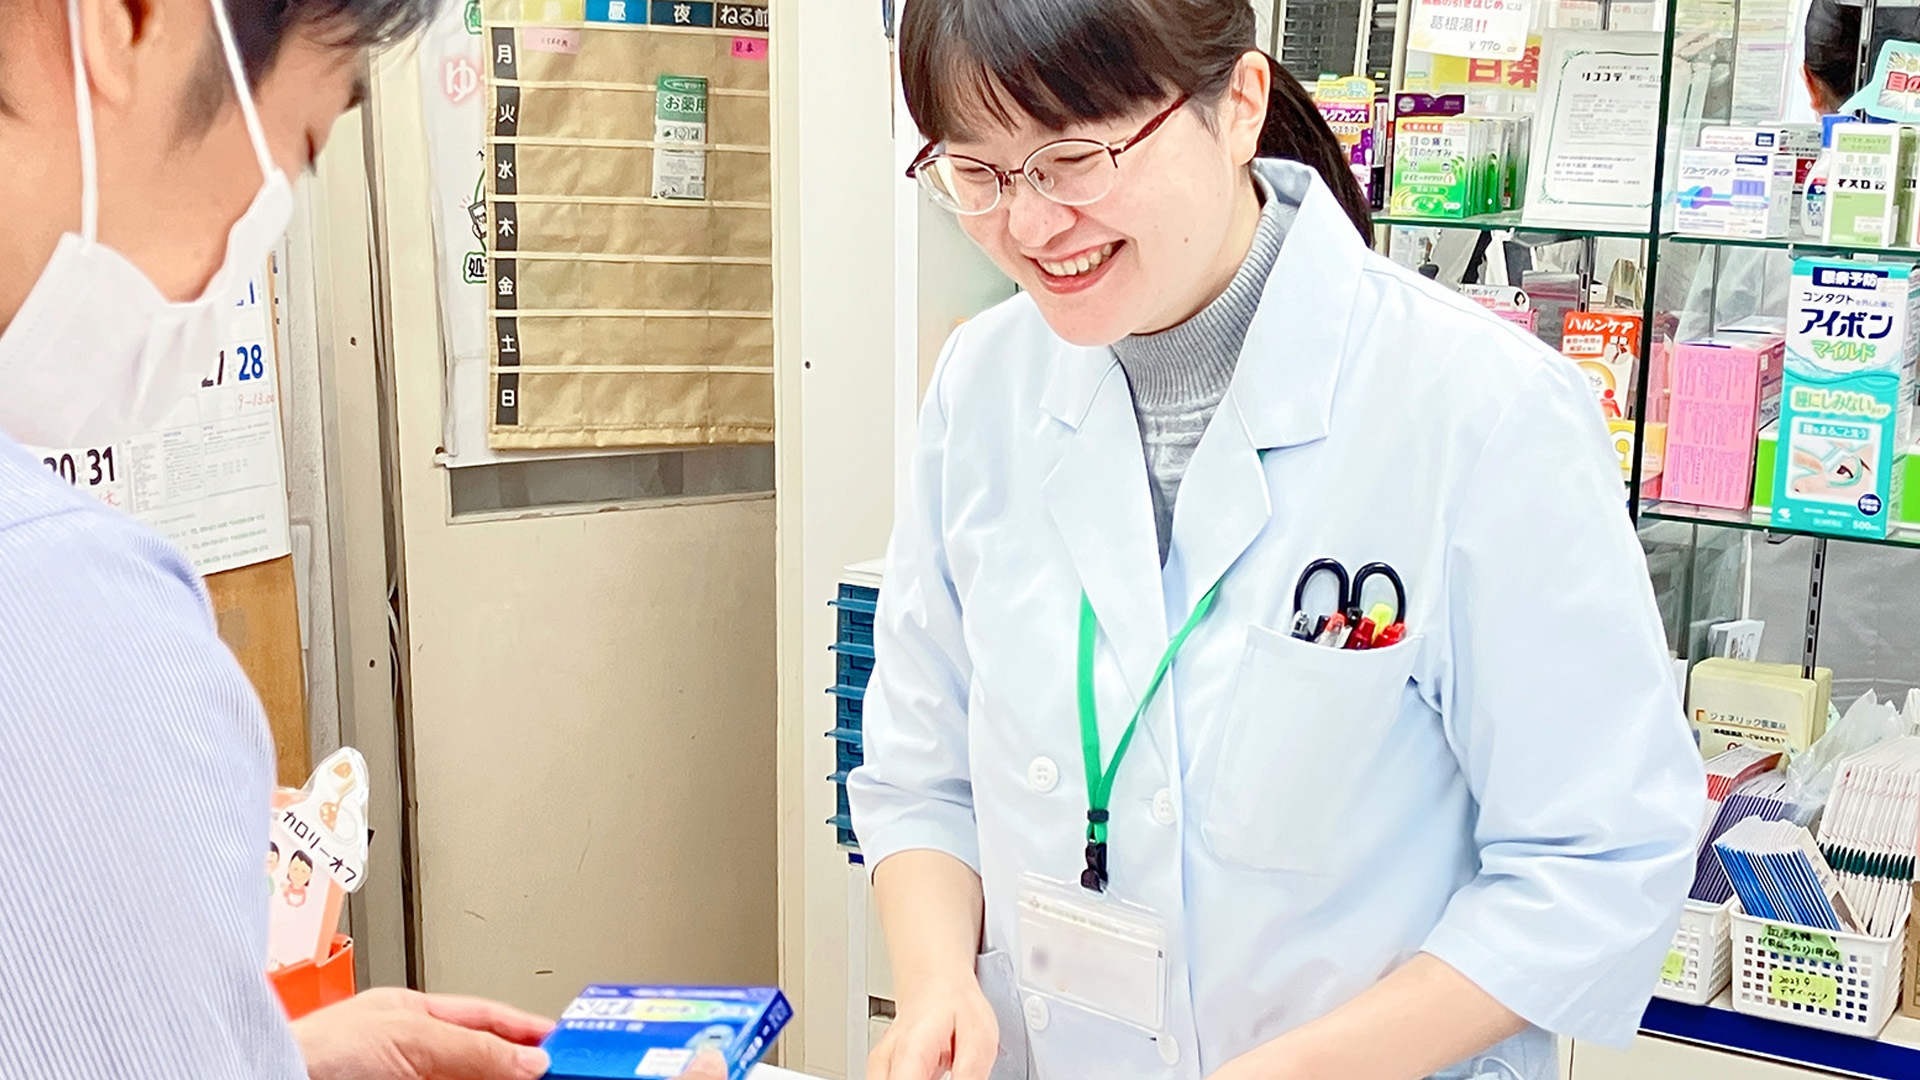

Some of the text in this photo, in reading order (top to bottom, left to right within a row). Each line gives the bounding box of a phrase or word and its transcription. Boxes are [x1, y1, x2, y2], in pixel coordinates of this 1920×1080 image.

[674, 4, 692, 24] 夜
[719, 5, 769, 27] ねる前
[497, 44, 513, 64] 月
[1481, 40, 1501, 52] 770
[444, 58, 478, 103] ゆ
[499, 104, 515, 123] 火
[498, 160, 514, 179] 水
[498, 217, 515, 236] 木
[497, 276, 514, 295] 金
[1821, 270, 1878, 288] 眼病予防
[1568, 318, 1634, 335] ハルンケア
[1799, 308, 1893, 339] アイボン
[501, 335, 516, 352] 土
[1811, 340, 1877, 362] マイルド
[237, 344, 264, 381] 28
[502, 389, 515, 407] 日
[87, 446, 115, 486] 31
[1710, 712, 1786, 731] ジェネリック医薬品
[283, 811, 357, 883] カロリーオフ
